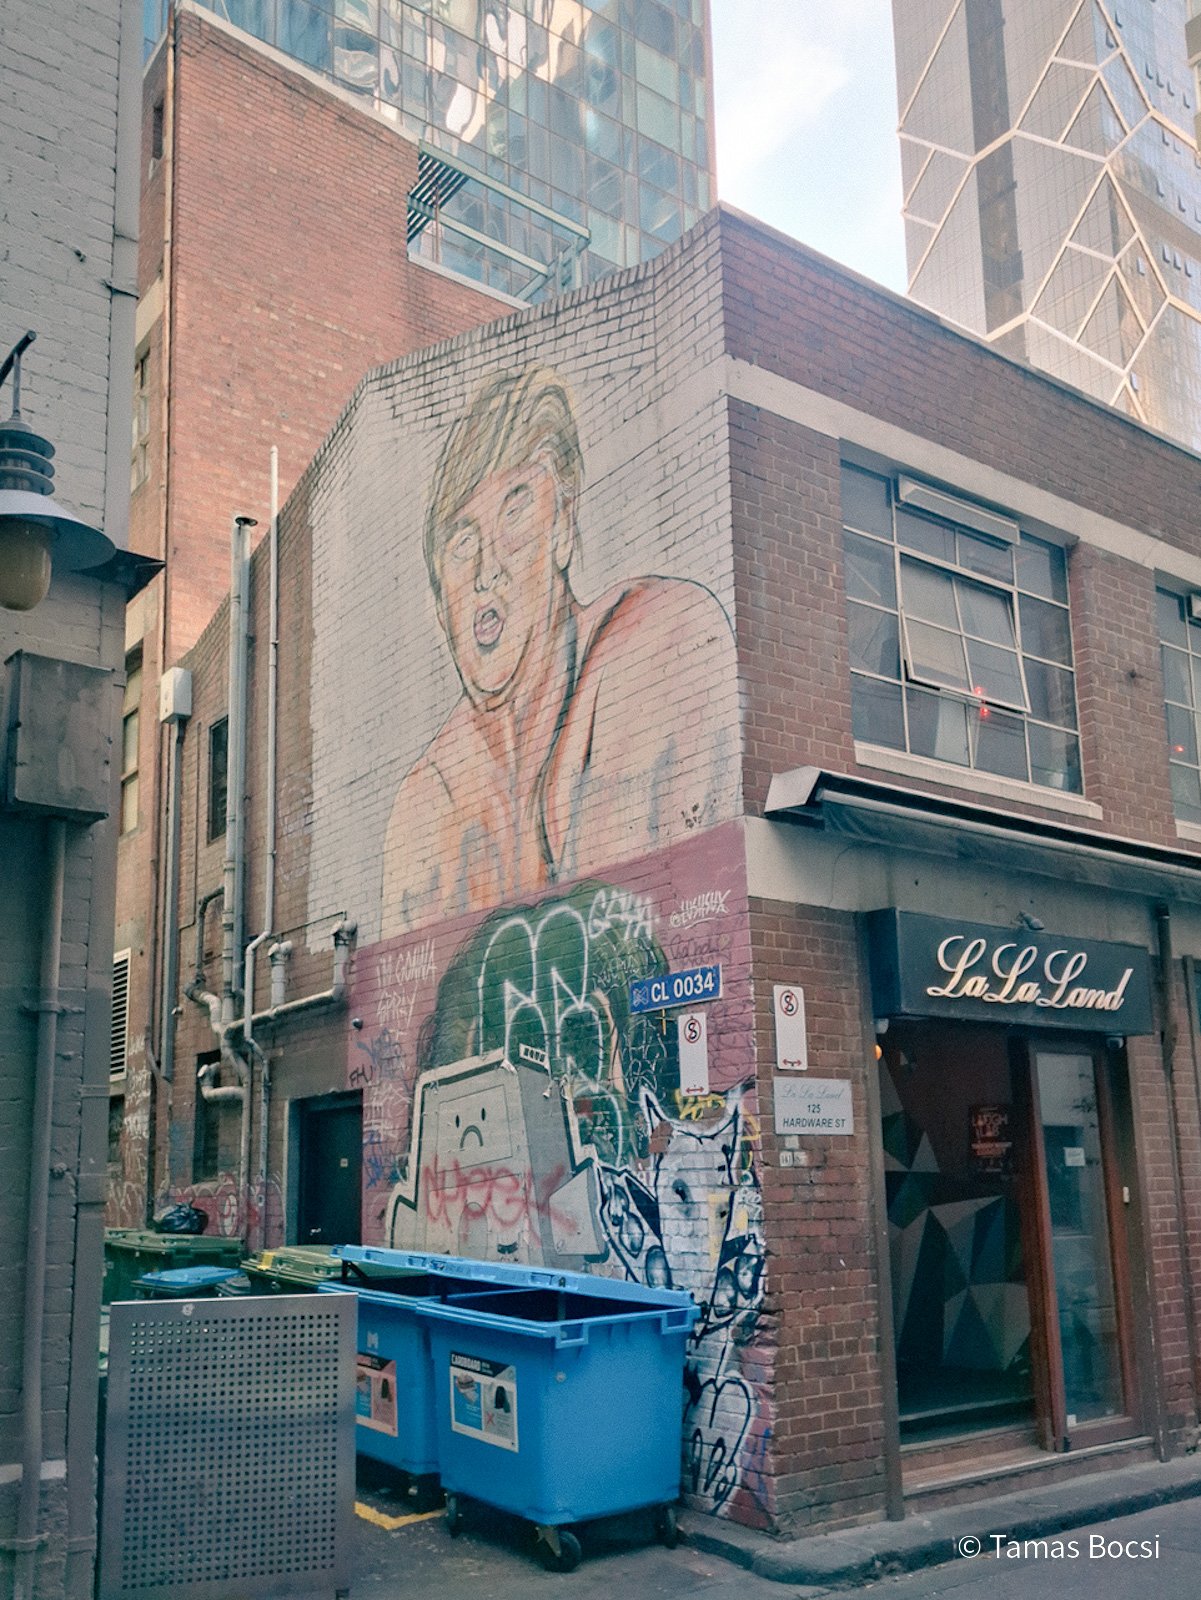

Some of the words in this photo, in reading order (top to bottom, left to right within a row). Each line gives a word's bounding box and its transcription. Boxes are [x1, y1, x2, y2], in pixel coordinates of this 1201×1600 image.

[927, 935, 989, 998] La
[983, 943, 1041, 1004] La
[1036, 949, 1134, 1011] Land
[651, 981, 669, 1003] CL
[674, 973, 714, 998] 0034
[807, 1103, 821, 1113] 125
[783, 1118, 833, 1128] HARDWARE
[834, 1118, 846, 1128] ST
